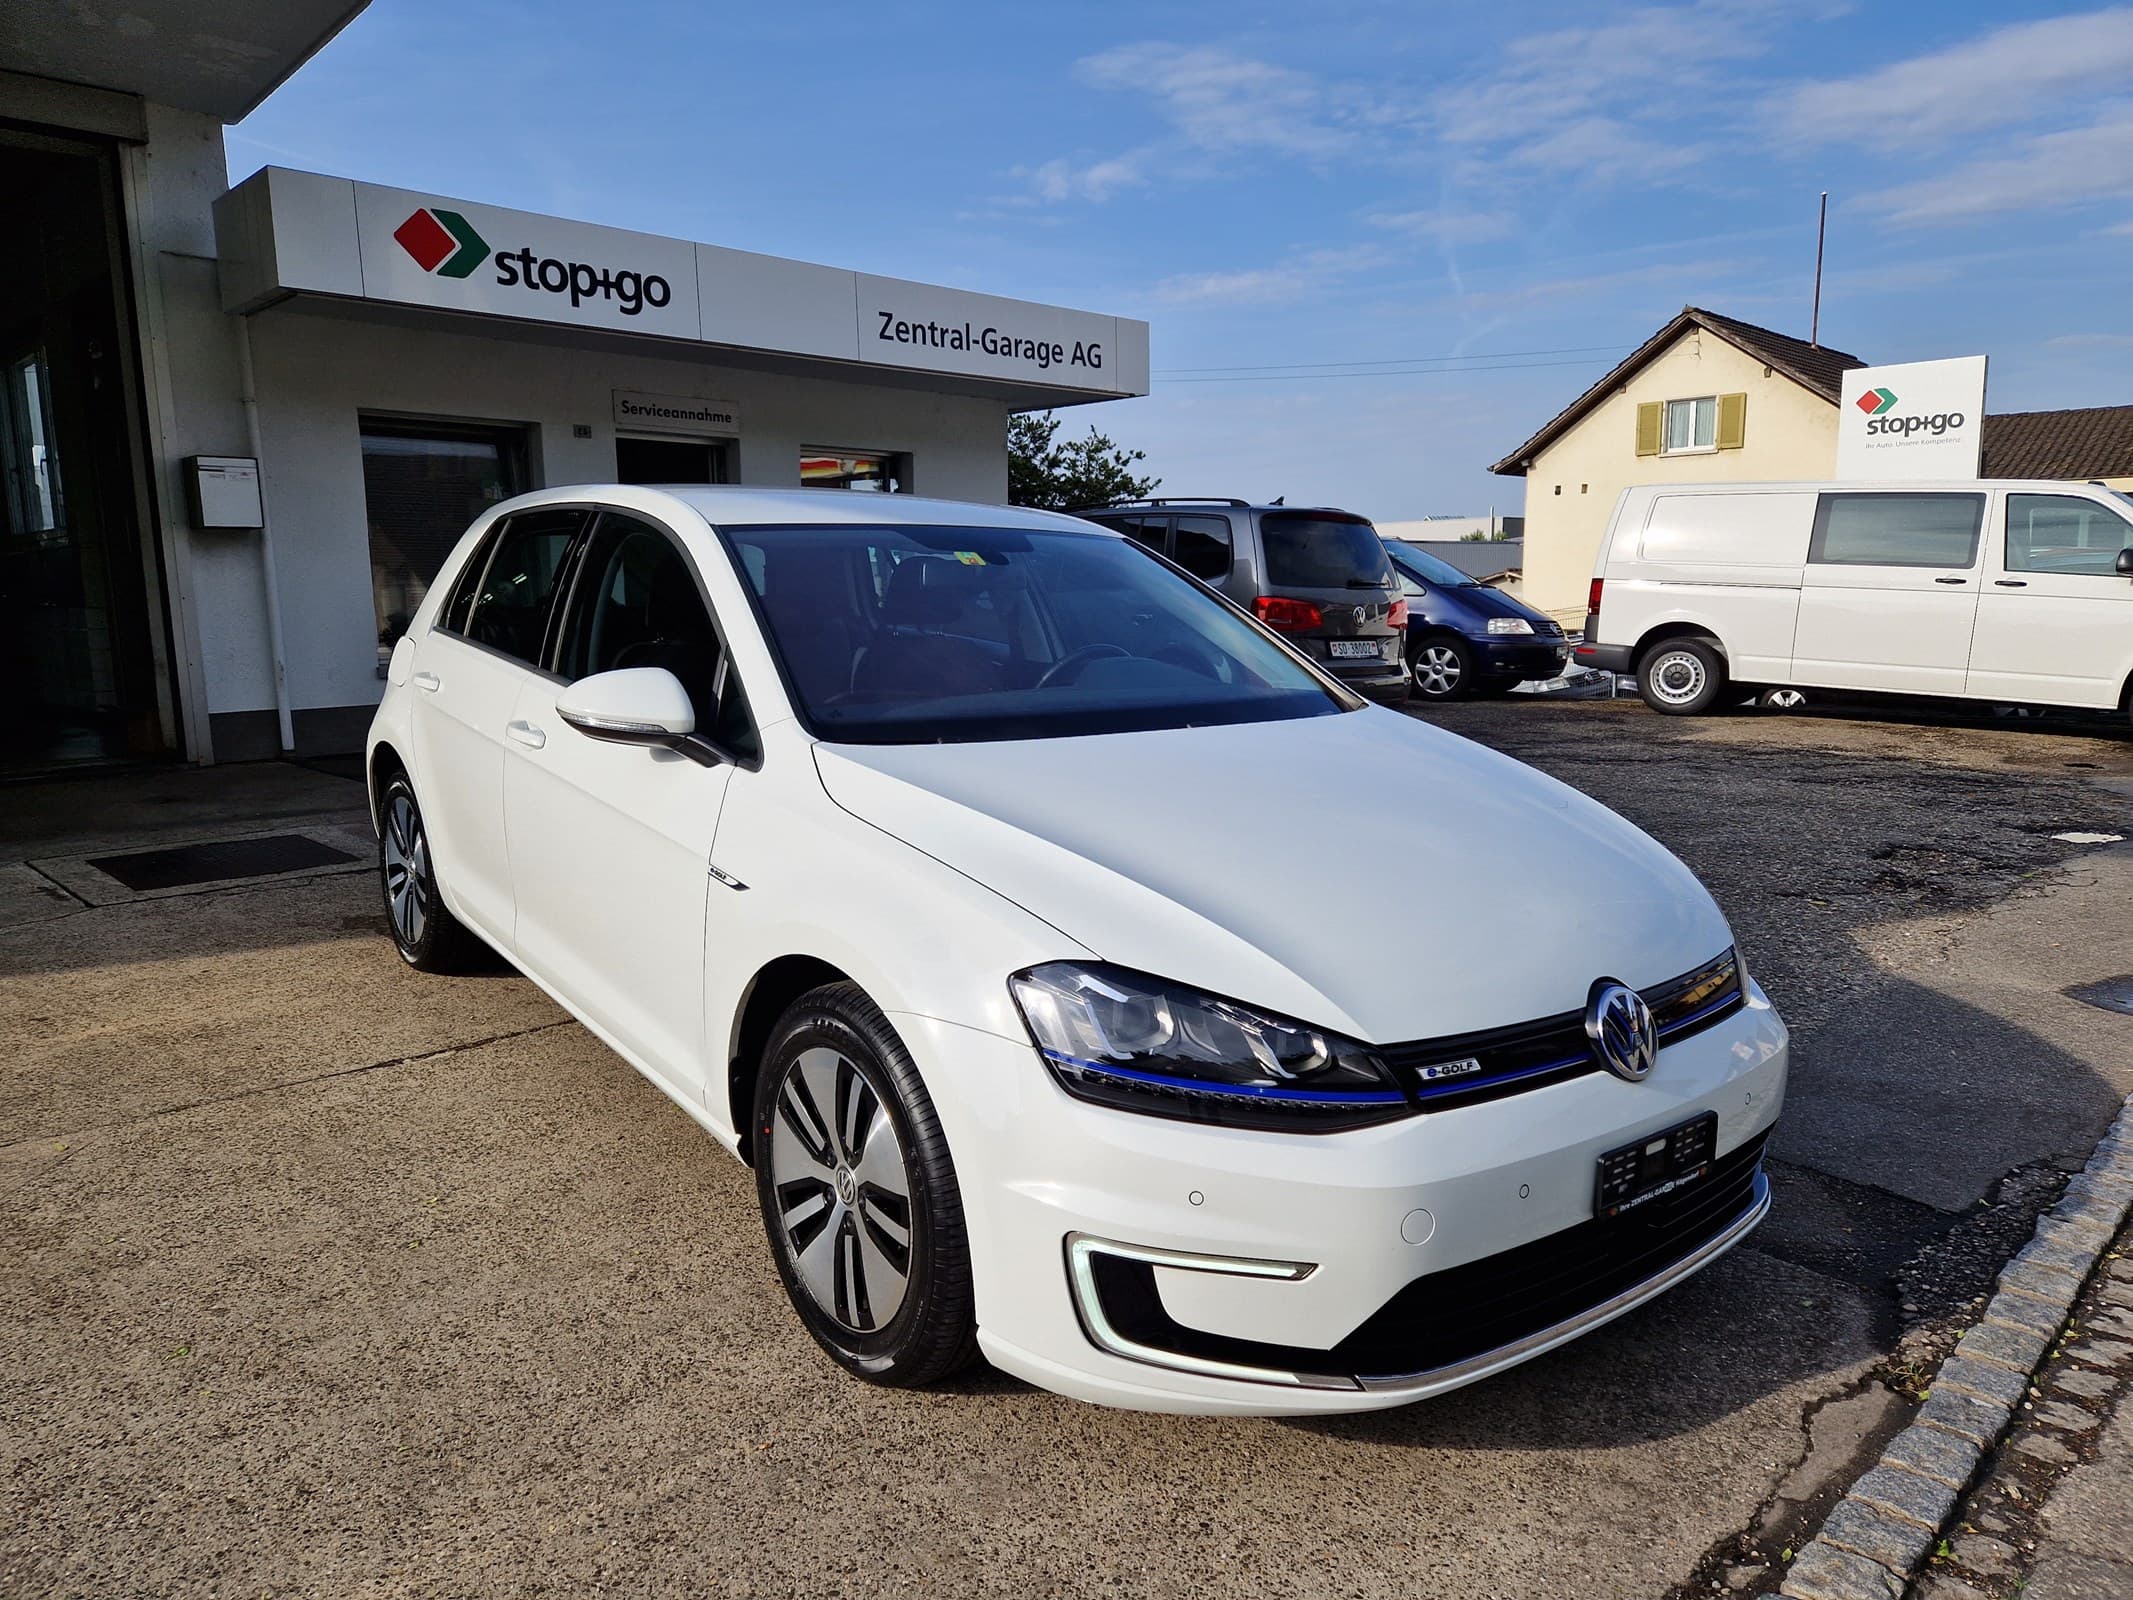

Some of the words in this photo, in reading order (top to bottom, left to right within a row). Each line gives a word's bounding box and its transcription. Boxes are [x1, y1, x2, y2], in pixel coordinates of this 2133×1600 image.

[495, 248, 671, 315] stop+go
[878, 311, 1064, 369] Zentral-Garage
[1070, 341, 1102, 369] AG
[621, 400, 732, 423] Serviceannahme
[1866, 413, 1965, 438] stop+go
[1895, 440, 1919, 448] Unsere
[1427, 1061, 1473, 1077] e-GOLF
